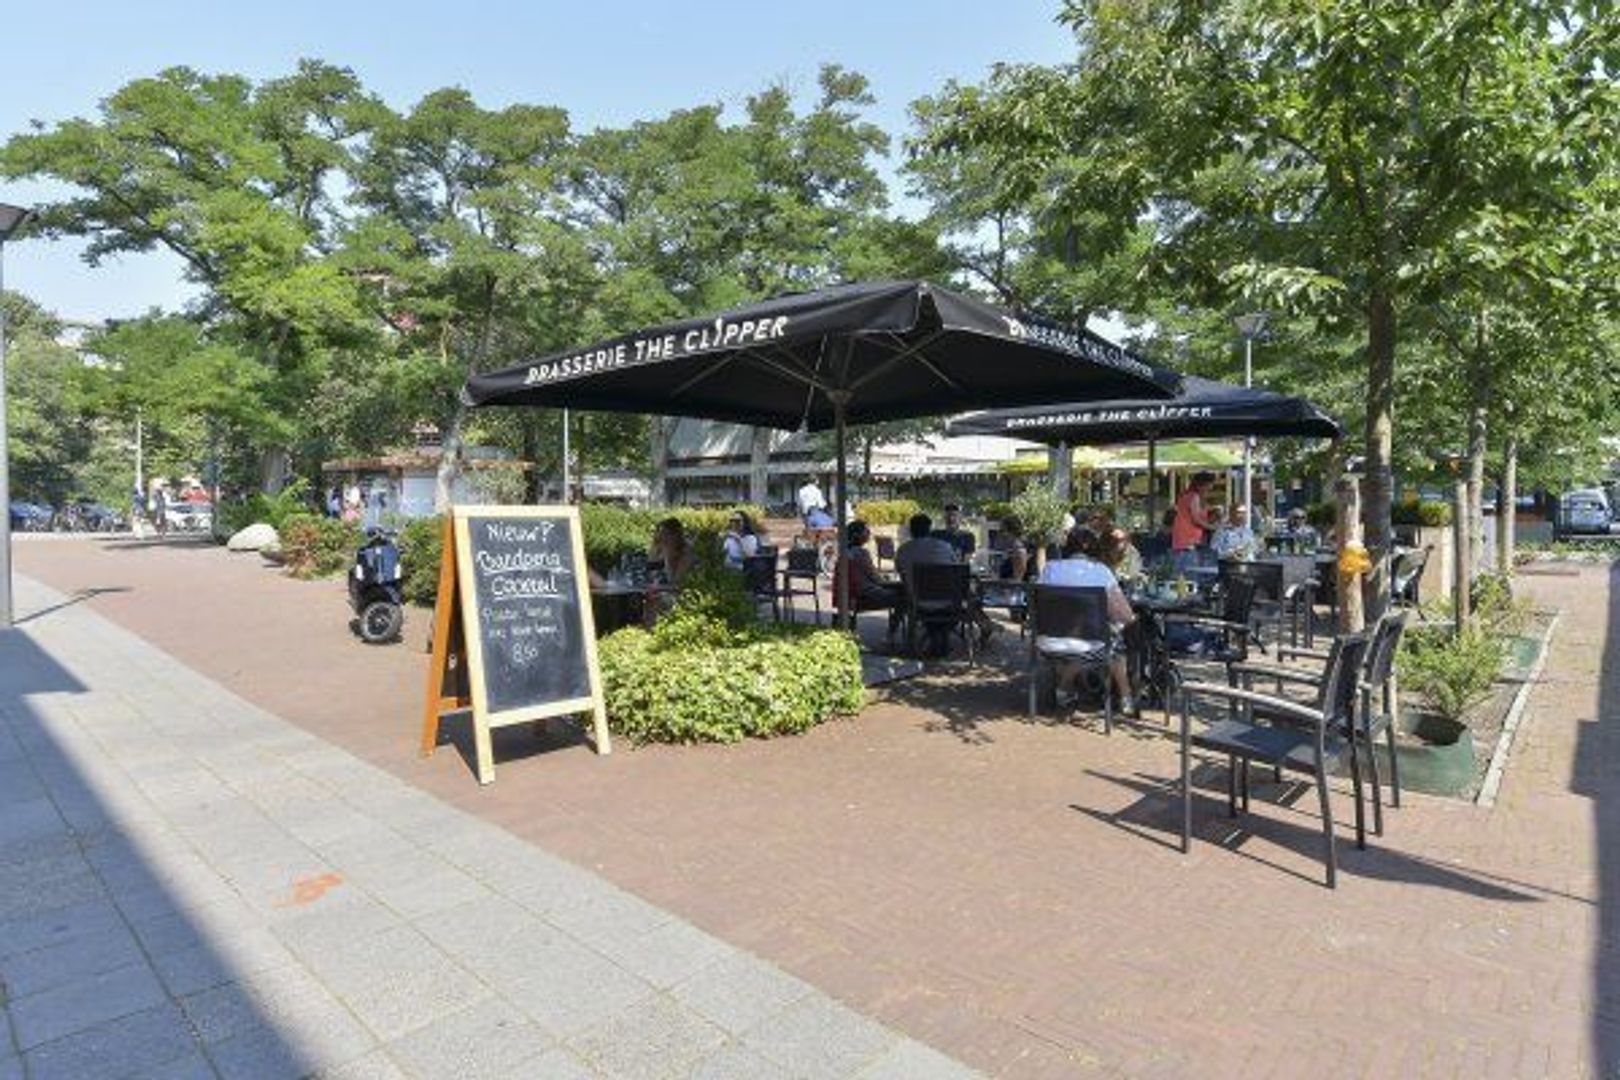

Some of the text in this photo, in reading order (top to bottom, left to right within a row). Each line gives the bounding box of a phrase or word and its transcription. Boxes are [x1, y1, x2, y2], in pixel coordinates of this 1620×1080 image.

[525, 316, 789, 384] BRASSERIE THE CLIPPER
[1100, 410, 1131, 422] THE
